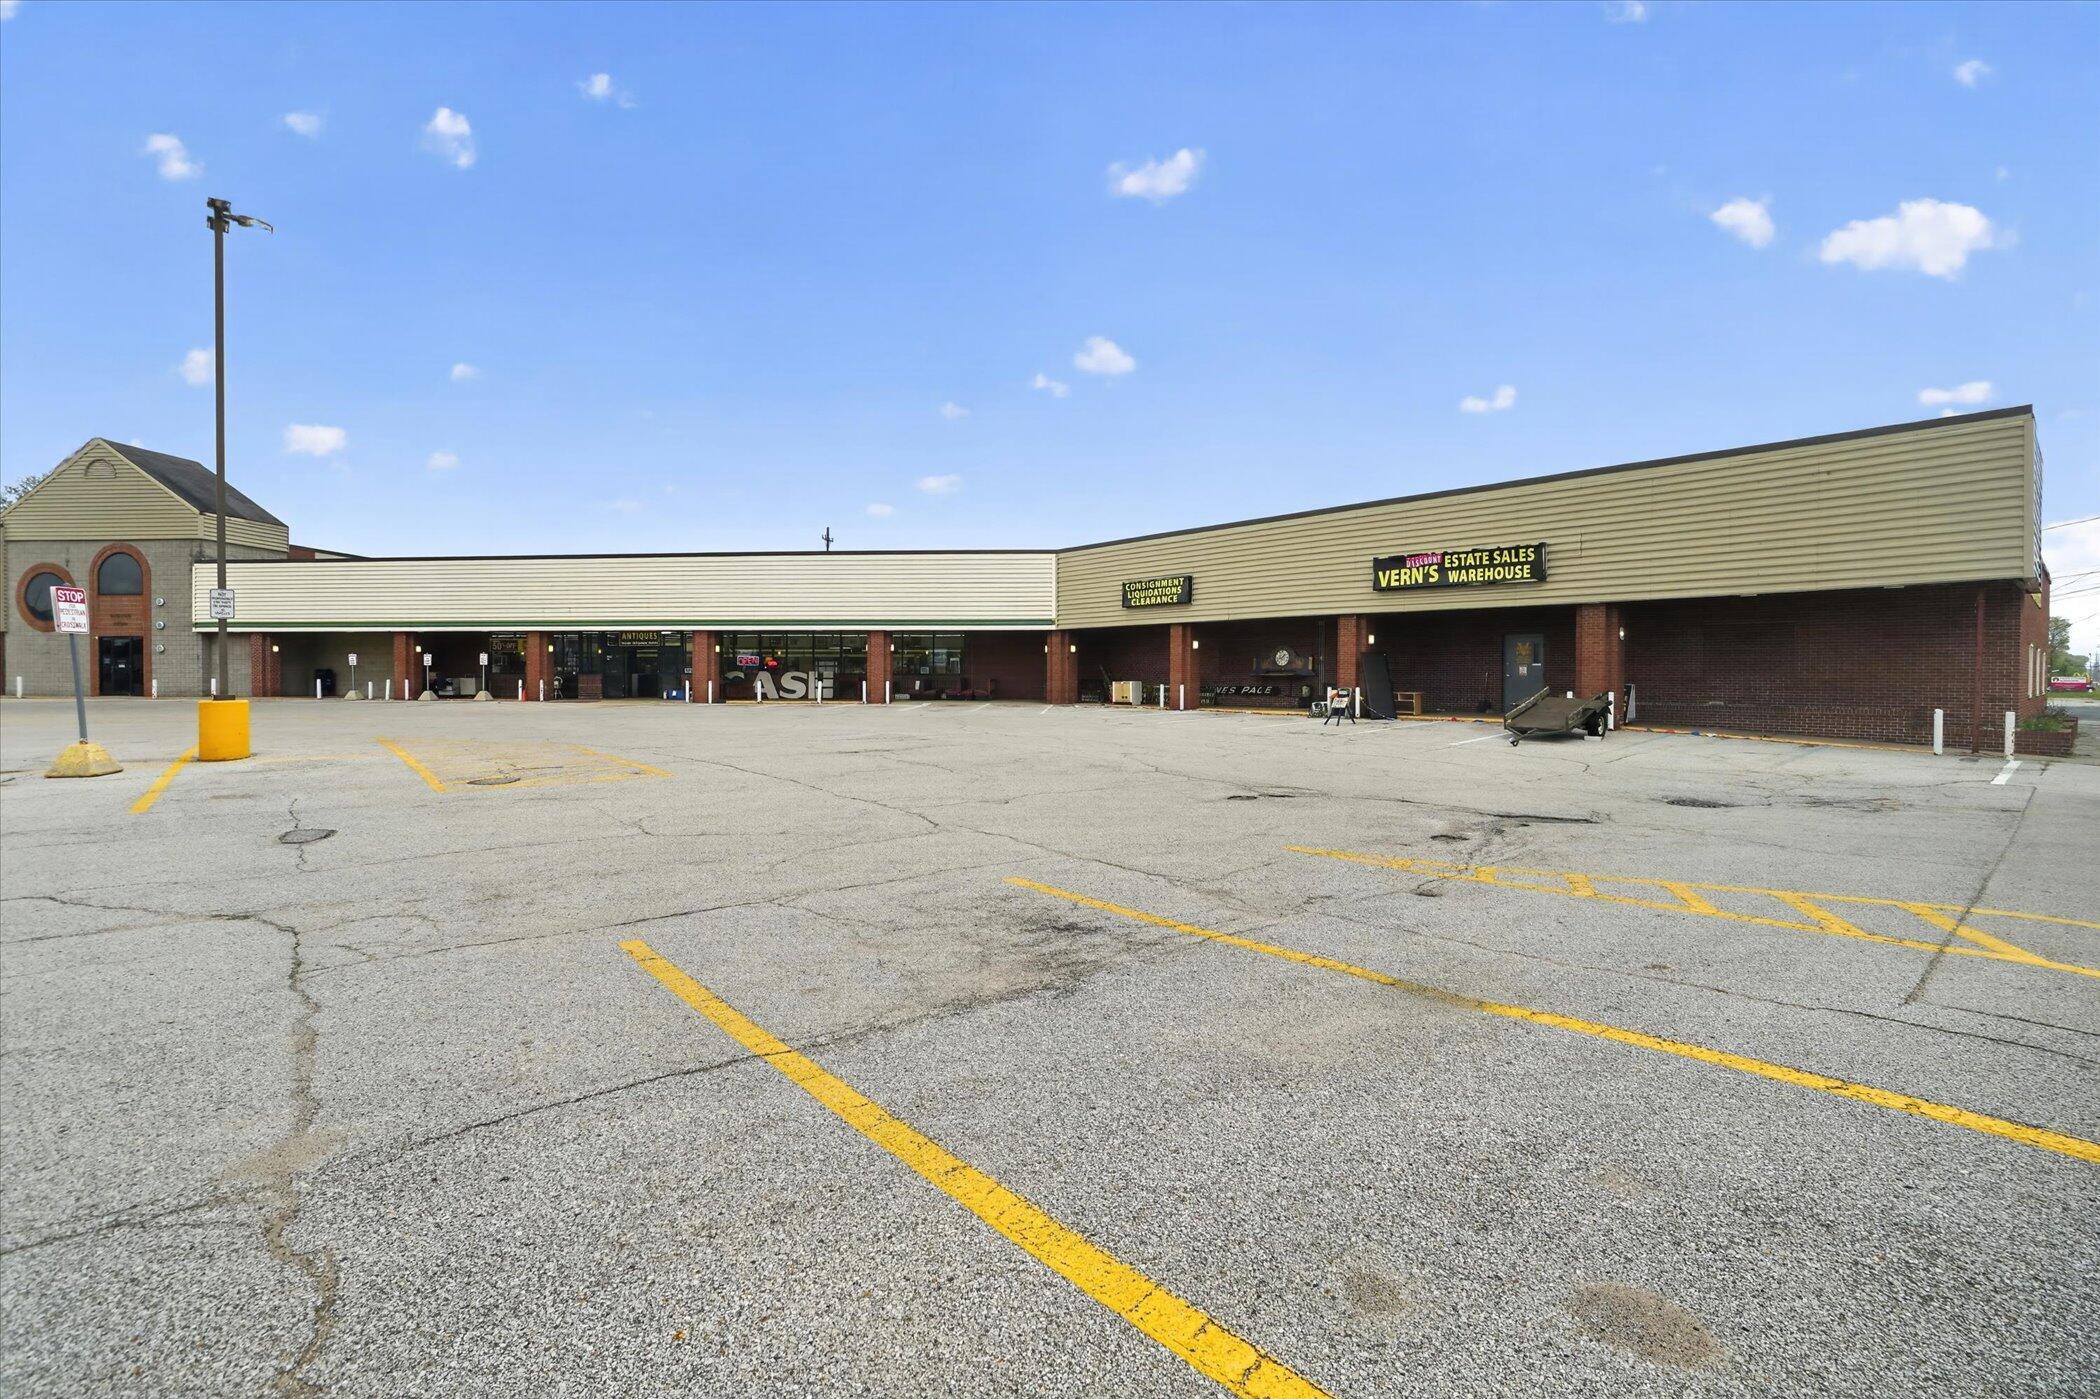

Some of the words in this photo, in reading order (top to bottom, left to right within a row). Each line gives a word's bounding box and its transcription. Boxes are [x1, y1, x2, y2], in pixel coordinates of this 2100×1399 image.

[1406, 554, 1442, 567] DISCOUNT
[1444, 551, 1489, 568] ESTATE
[1493, 547, 1535, 564] SALES
[1378, 565, 1439, 588] VERN'S
[1447, 564, 1531, 583] WAREHOUSE
[1125, 577, 1184, 591] CONSIGNMENT
[57, 589, 84, 602] STOP
[1127, 586, 1182, 599] LIQUIDATIONS
[1131, 594, 1178, 606] CLEARANCE
[621, 632, 658, 640] ANTIQUES
